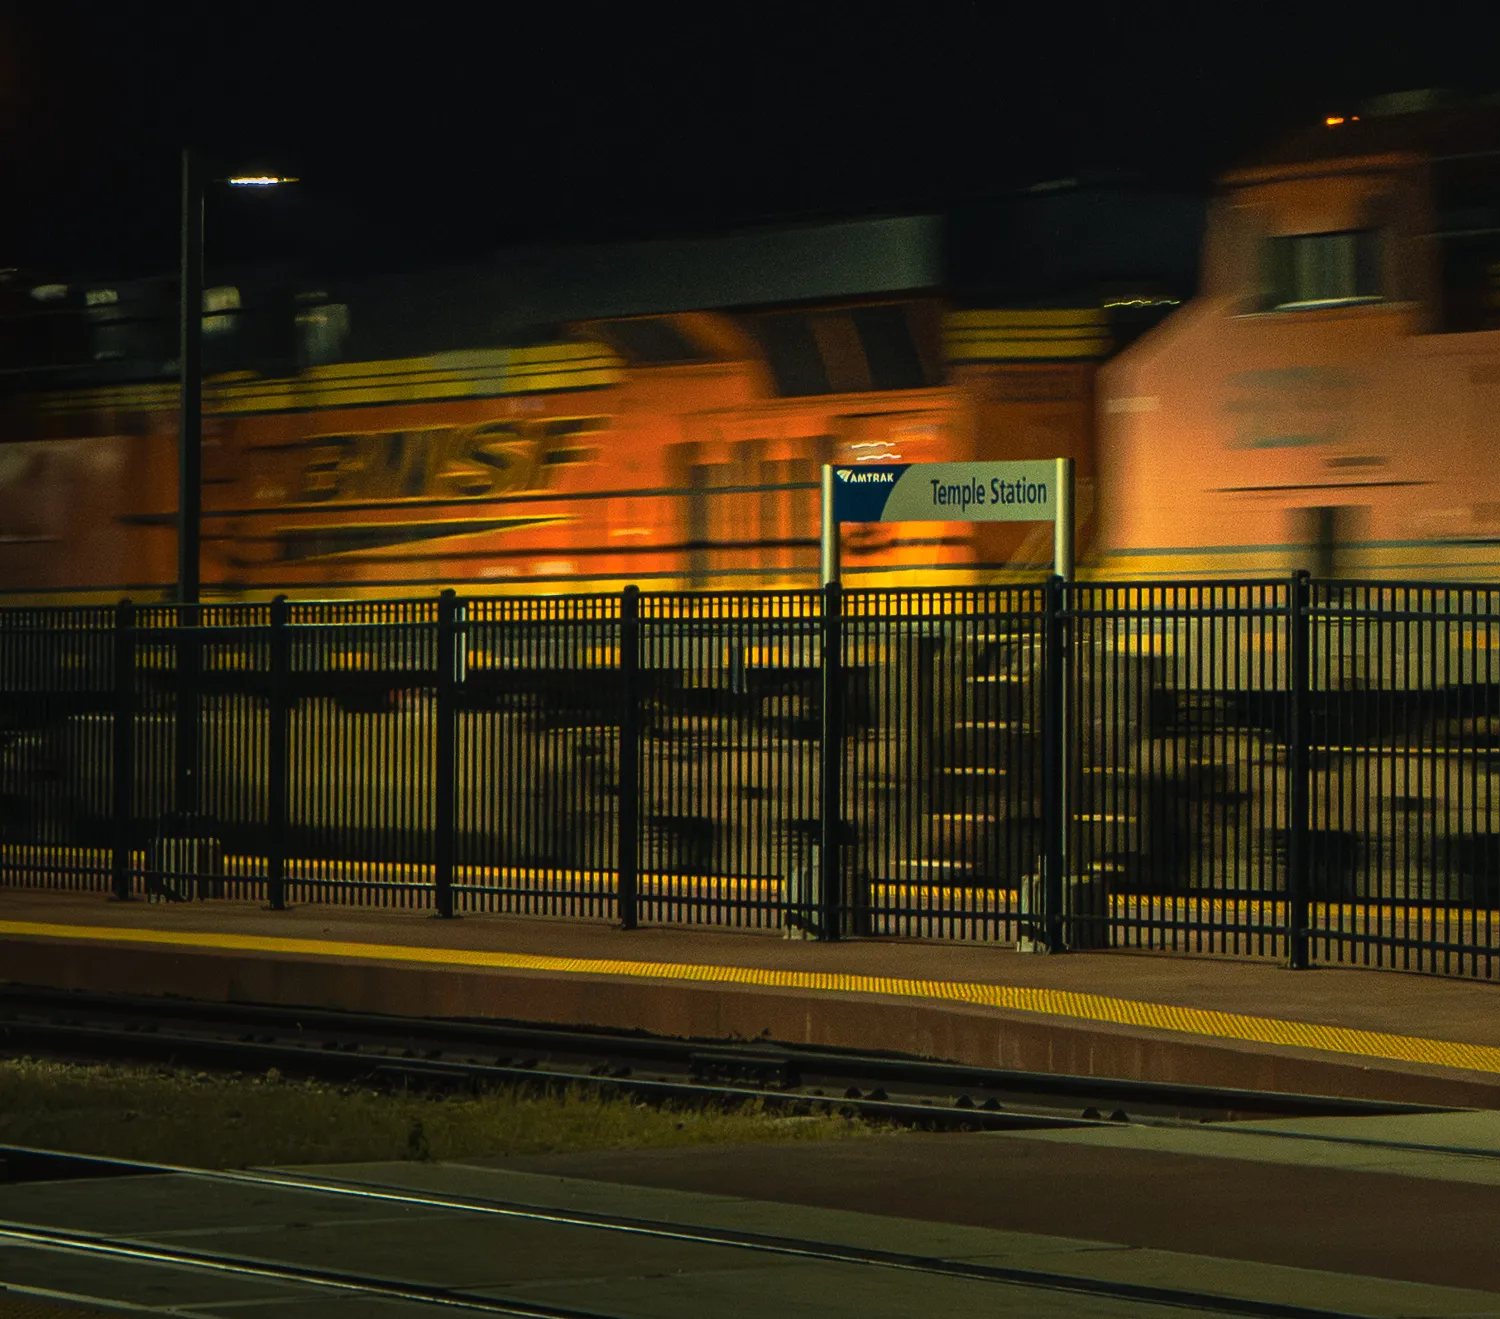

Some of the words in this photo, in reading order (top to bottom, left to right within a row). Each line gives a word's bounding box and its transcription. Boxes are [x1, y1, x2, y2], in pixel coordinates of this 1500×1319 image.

[850, 472, 894, 483] AMTRAK
[930, 476, 986, 512] Temple
[990, 476, 1047, 505] Station
